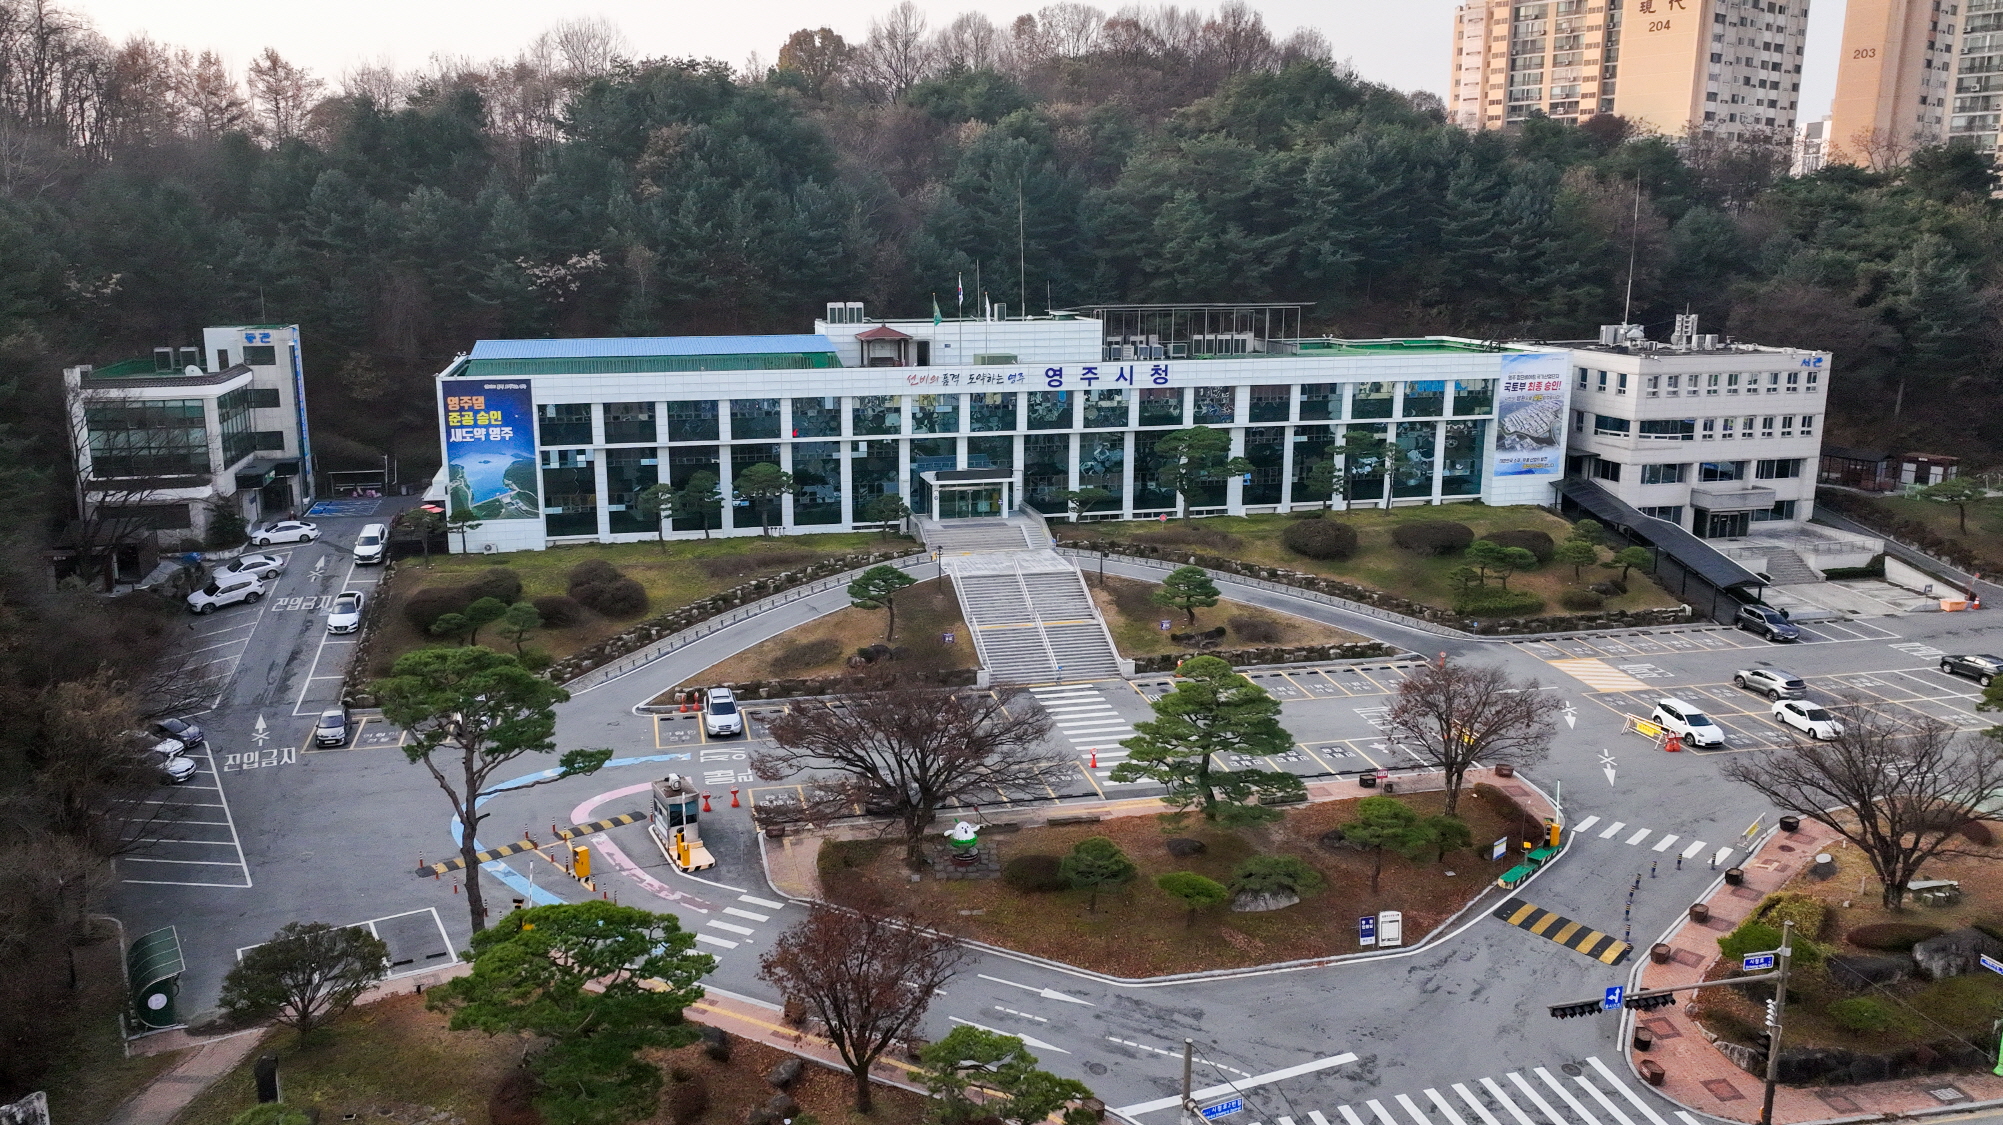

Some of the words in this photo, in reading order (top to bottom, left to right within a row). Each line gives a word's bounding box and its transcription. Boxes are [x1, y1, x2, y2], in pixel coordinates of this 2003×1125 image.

[1648, 20, 1671, 32] 204
[1853, 48, 1876, 60] 203
[907, 374, 939, 386] 선비의
[942, 372, 960, 386] 품격
[967, 372, 1005, 385] 도약하는
[1008, 372, 1026, 384] 영주
[1045, 364, 1169, 388] 영주시청
[1504, 381, 1526, 392] 국토부
[1528, 381, 1543, 391] 최종
[1544, 380, 1562, 391] 승인!
[447, 396, 485, 410] 영주댐
[448, 411, 474, 426] 준공
[476, 410, 502, 425] 승인
[450, 428, 486, 442] 새도약
[489, 427, 513, 441] 영주
[271, 595, 332, 612] 진입금지
[224, 747, 296, 772] 진입금지
